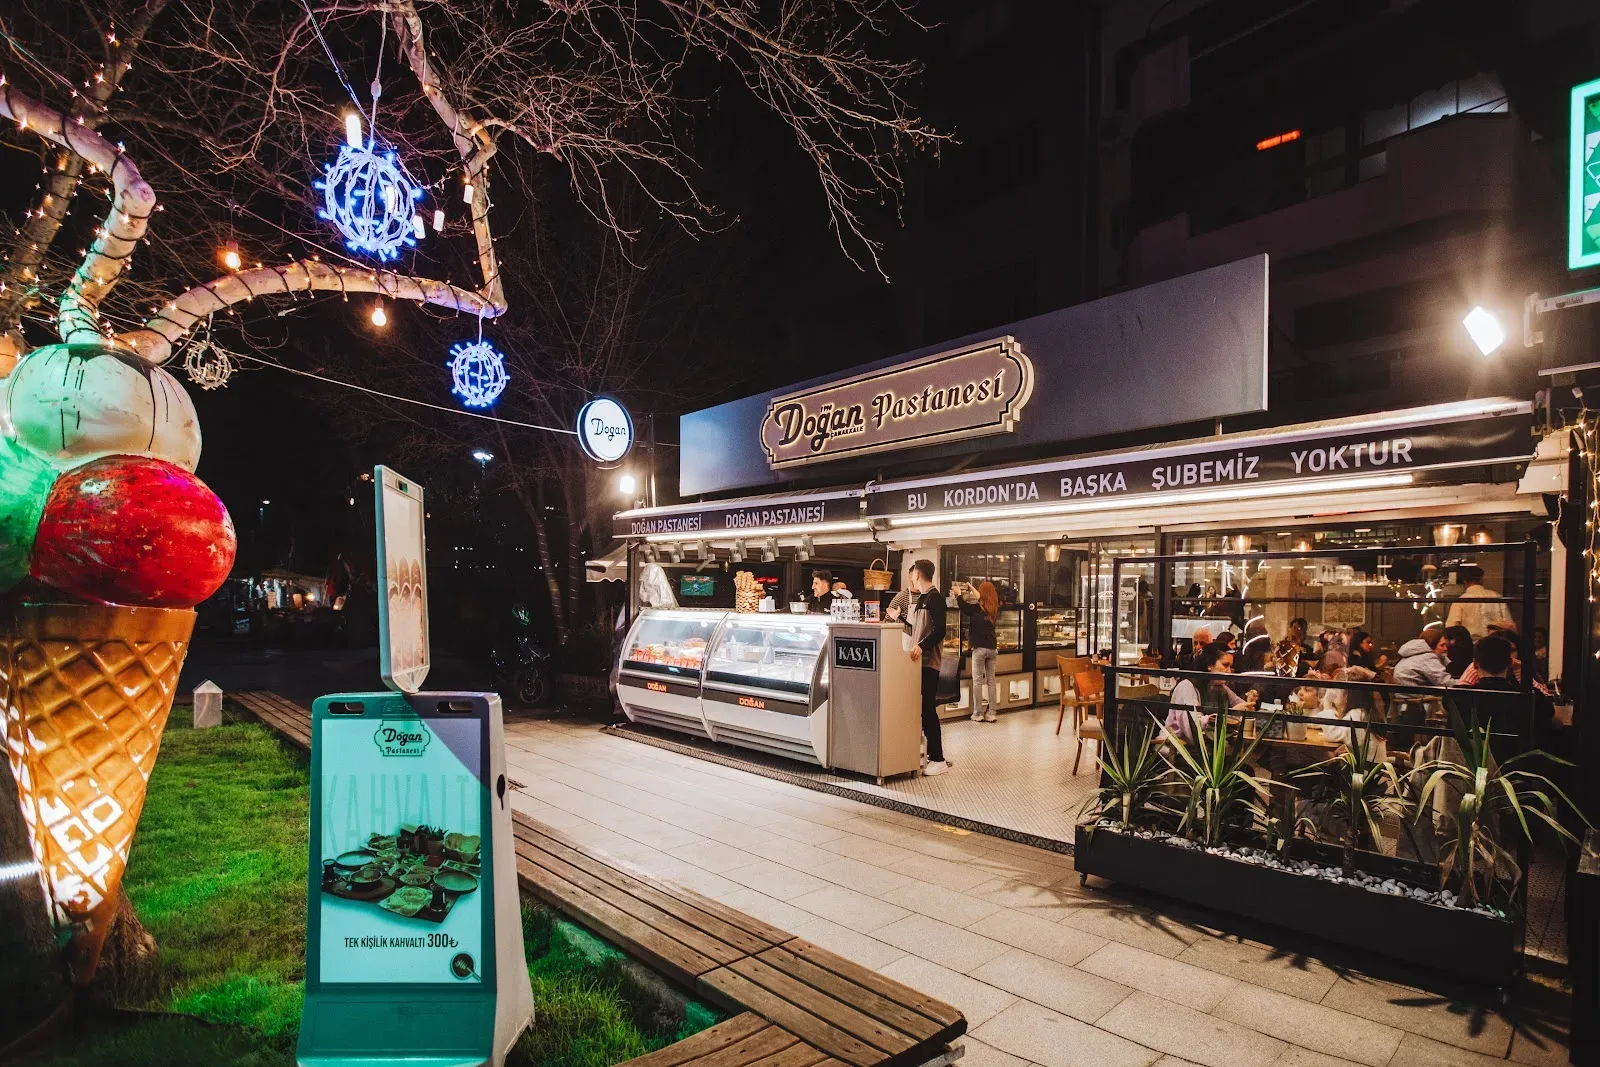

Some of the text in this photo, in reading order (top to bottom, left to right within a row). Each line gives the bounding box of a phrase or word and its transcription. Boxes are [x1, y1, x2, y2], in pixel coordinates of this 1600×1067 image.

[907, 437, 1413, 510] BU KORDON'DA BAŞKA ŞUBEMİZ YOKTUR
[631, 513, 702, 535] DOĞAN PASTANESİ
[725, 502, 825, 529] DOĞAN PASTANESİ
[838, 646, 871, 662] KASA
[739, 697, 765, 709] DOĞAN
[344, 937, 359, 948] TEK
[361, 935, 388, 949] KİŞİLİK
[390, 937, 425, 948] KAHVALTI
